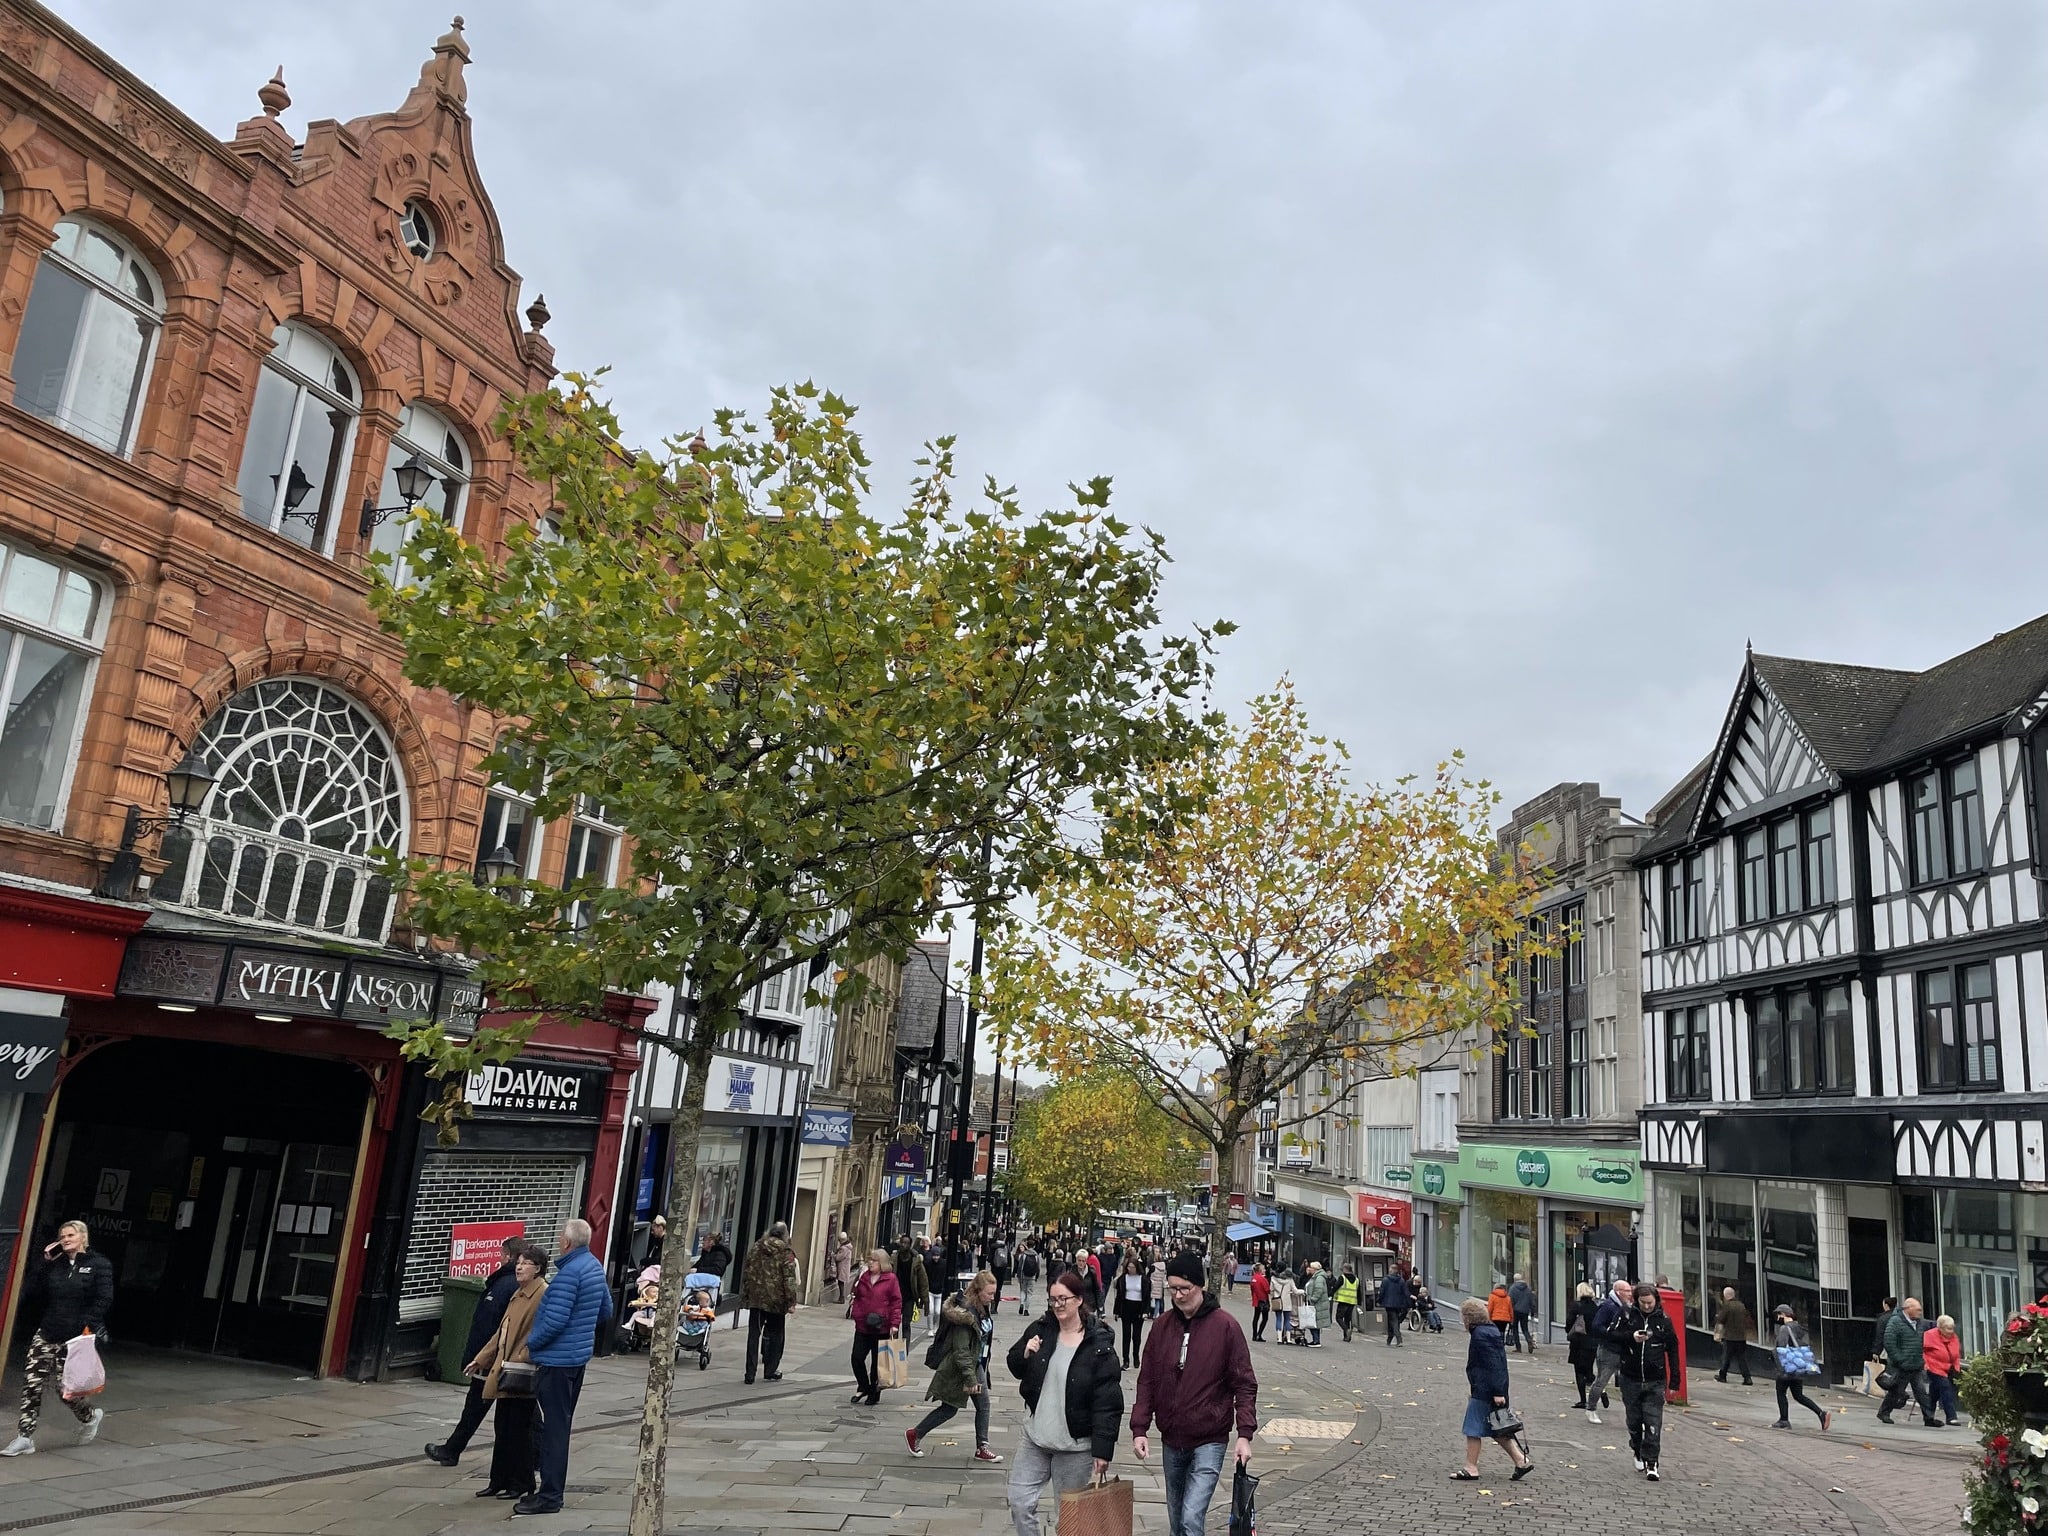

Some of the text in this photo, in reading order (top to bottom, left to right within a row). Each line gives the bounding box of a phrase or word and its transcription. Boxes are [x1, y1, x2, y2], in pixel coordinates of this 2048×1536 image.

[239, 960, 434, 1012] MAKINSON
[729, 1079, 755, 1095] HALIFAX
[491, 1096, 578, 1111] MENSWEAR
[804, 1122, 849, 1135] HALIFAX
[895, 1161, 915, 1169] NatWest
[1518, 1159, 1546, 1175] Specsavers
[1424, 1171, 1442, 1184] Specsavers
[1595, 1171, 1629, 1180] Specsavers
[465, 1238, 504, 1251] barkerprou
